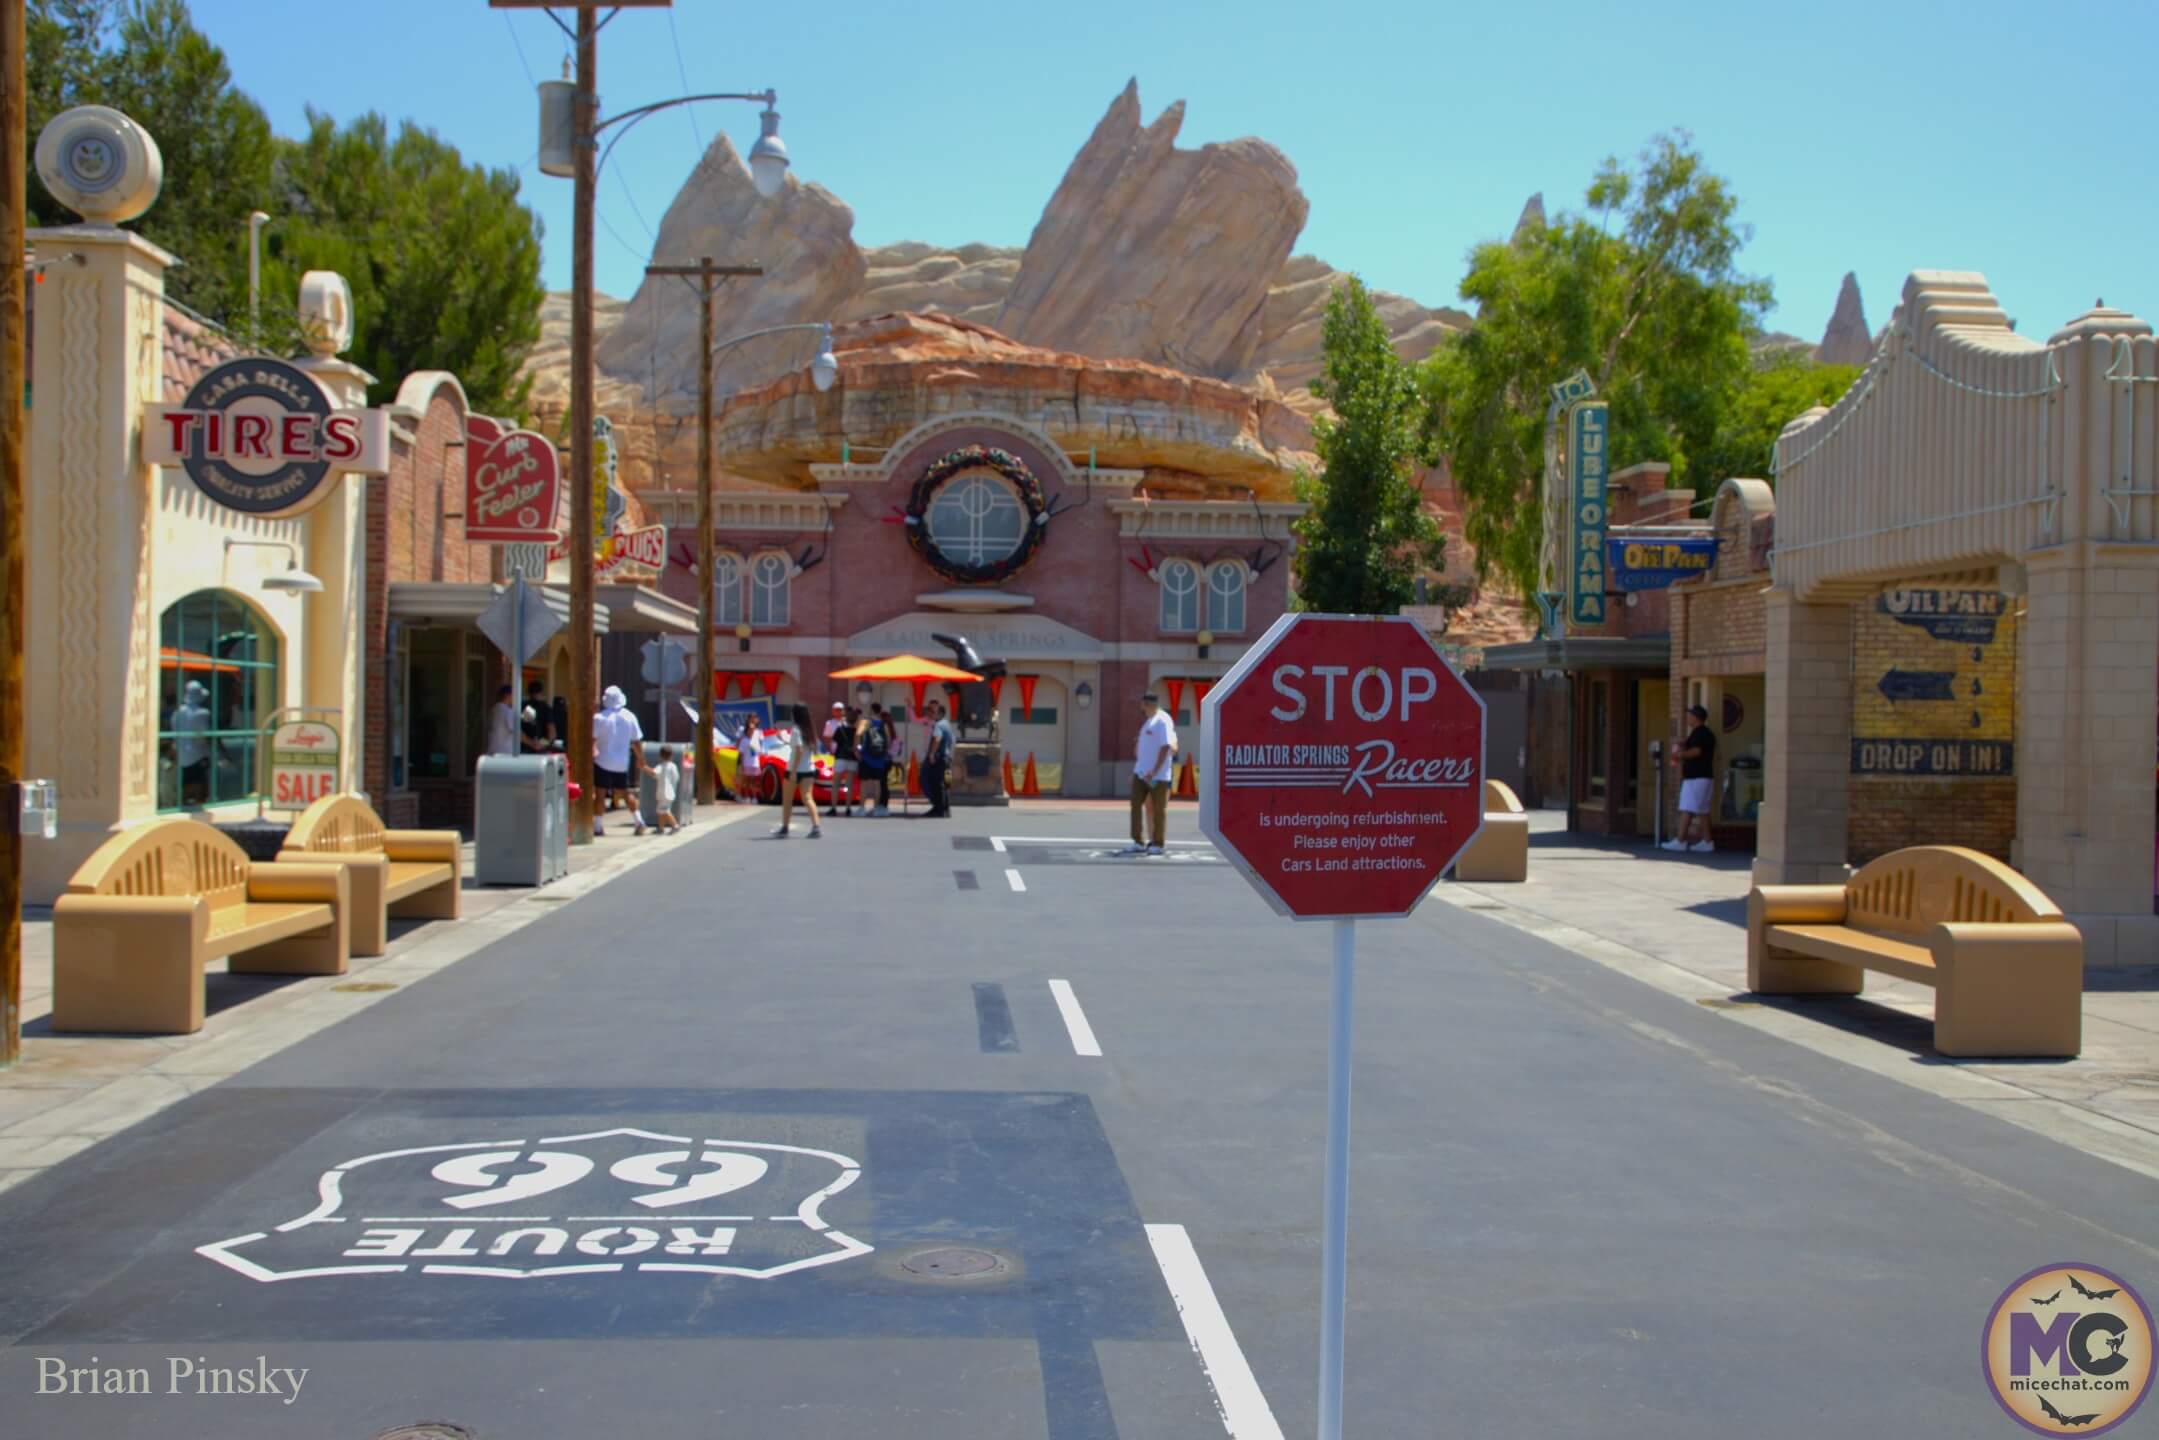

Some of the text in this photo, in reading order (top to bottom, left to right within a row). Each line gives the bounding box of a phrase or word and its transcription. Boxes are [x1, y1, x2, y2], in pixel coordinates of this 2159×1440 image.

[201, 371, 249, 406] CASA
[162, 412, 363, 459] TIRES
[474, 451, 539, 493] Curb
[472, 479, 547, 525] Feeler
[1270, 665, 1437, 722] STOP
[1225, 739, 1475, 799] RADIATOR SPRINGS Racers
[1860, 743, 2001, 771] DROP ON IN!
[1259, 811, 1448, 829] is undergoing refurbishment.
[1293, 834, 1415, 851] Please enjoy other
[1281, 855, 1426, 872] Cars Land attractions.
[431, 1151, 768, 1209] 66
[343, 1226, 737, 1256] ROUTE
